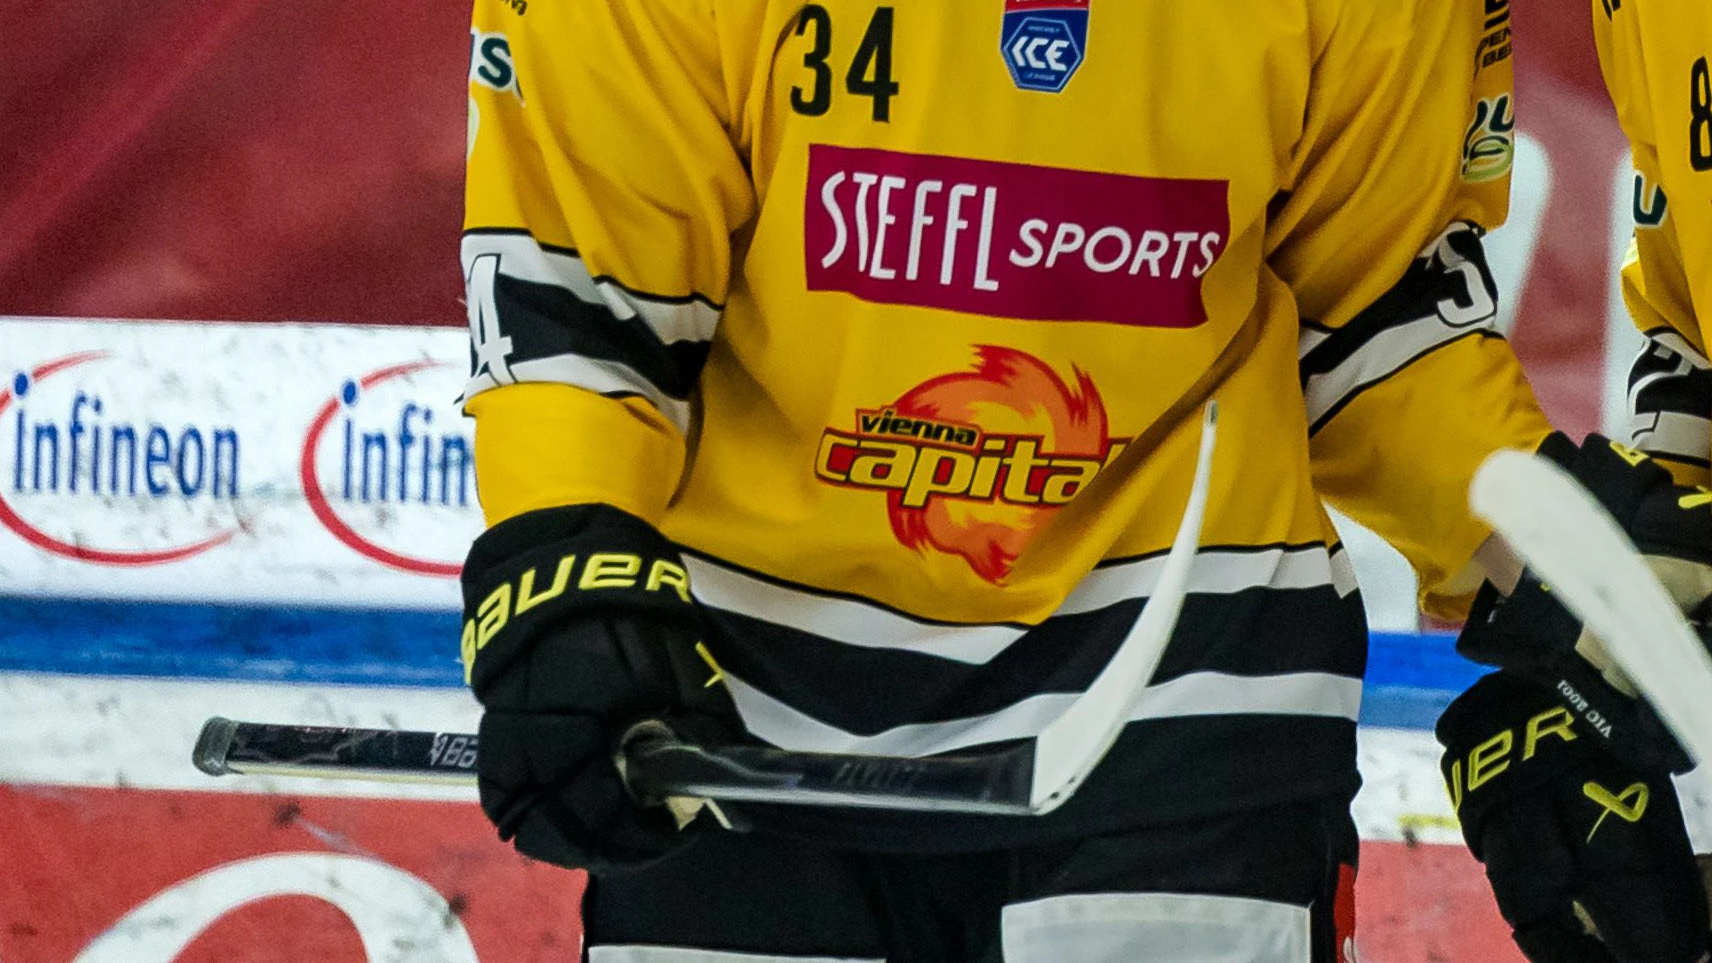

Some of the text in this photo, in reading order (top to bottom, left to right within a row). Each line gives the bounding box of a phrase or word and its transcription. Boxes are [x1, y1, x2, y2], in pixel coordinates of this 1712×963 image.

[790, 3, 899, 124] 34
[1011, 36, 1070, 71] ICE
[820, 170, 1220, 292] STEFFL SPORTS
[340, 379, 471, 507] infin
[815, 430, 1130, 509] capita
[860, 410, 978, 447] vienna
